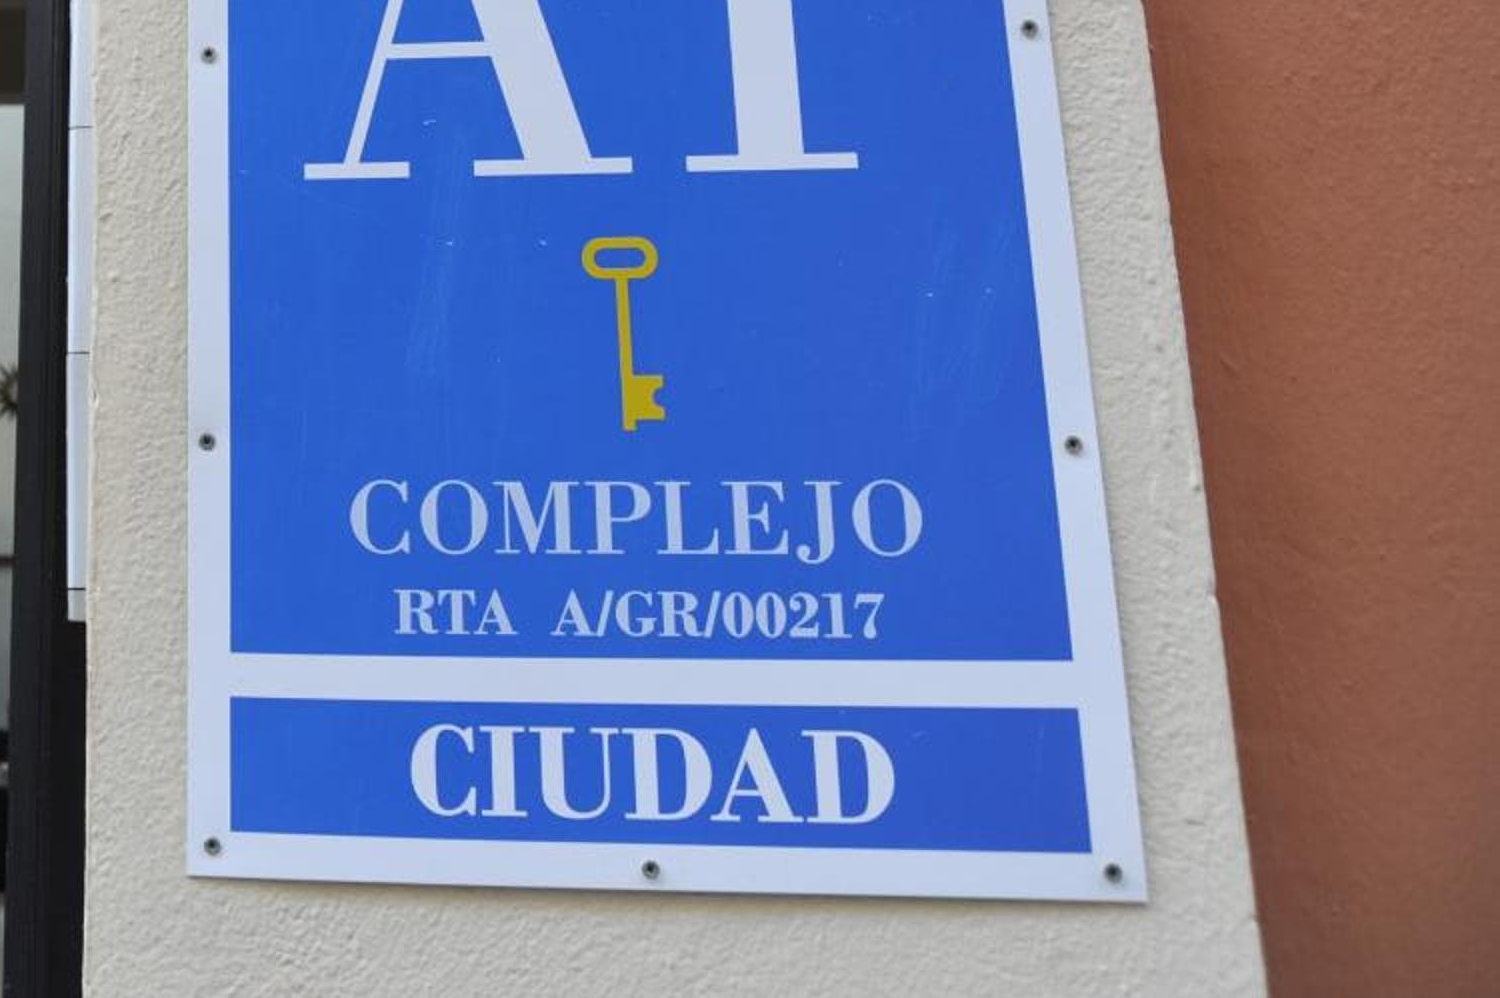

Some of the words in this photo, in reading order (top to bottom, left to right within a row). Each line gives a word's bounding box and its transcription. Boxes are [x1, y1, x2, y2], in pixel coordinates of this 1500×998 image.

[349, 478, 924, 566] COMPLEJO
[393, 588, 518, 636] RTA
[550, 590, 887, 640] A/GR/00217
[409, 723, 896, 825] CIUDAD
